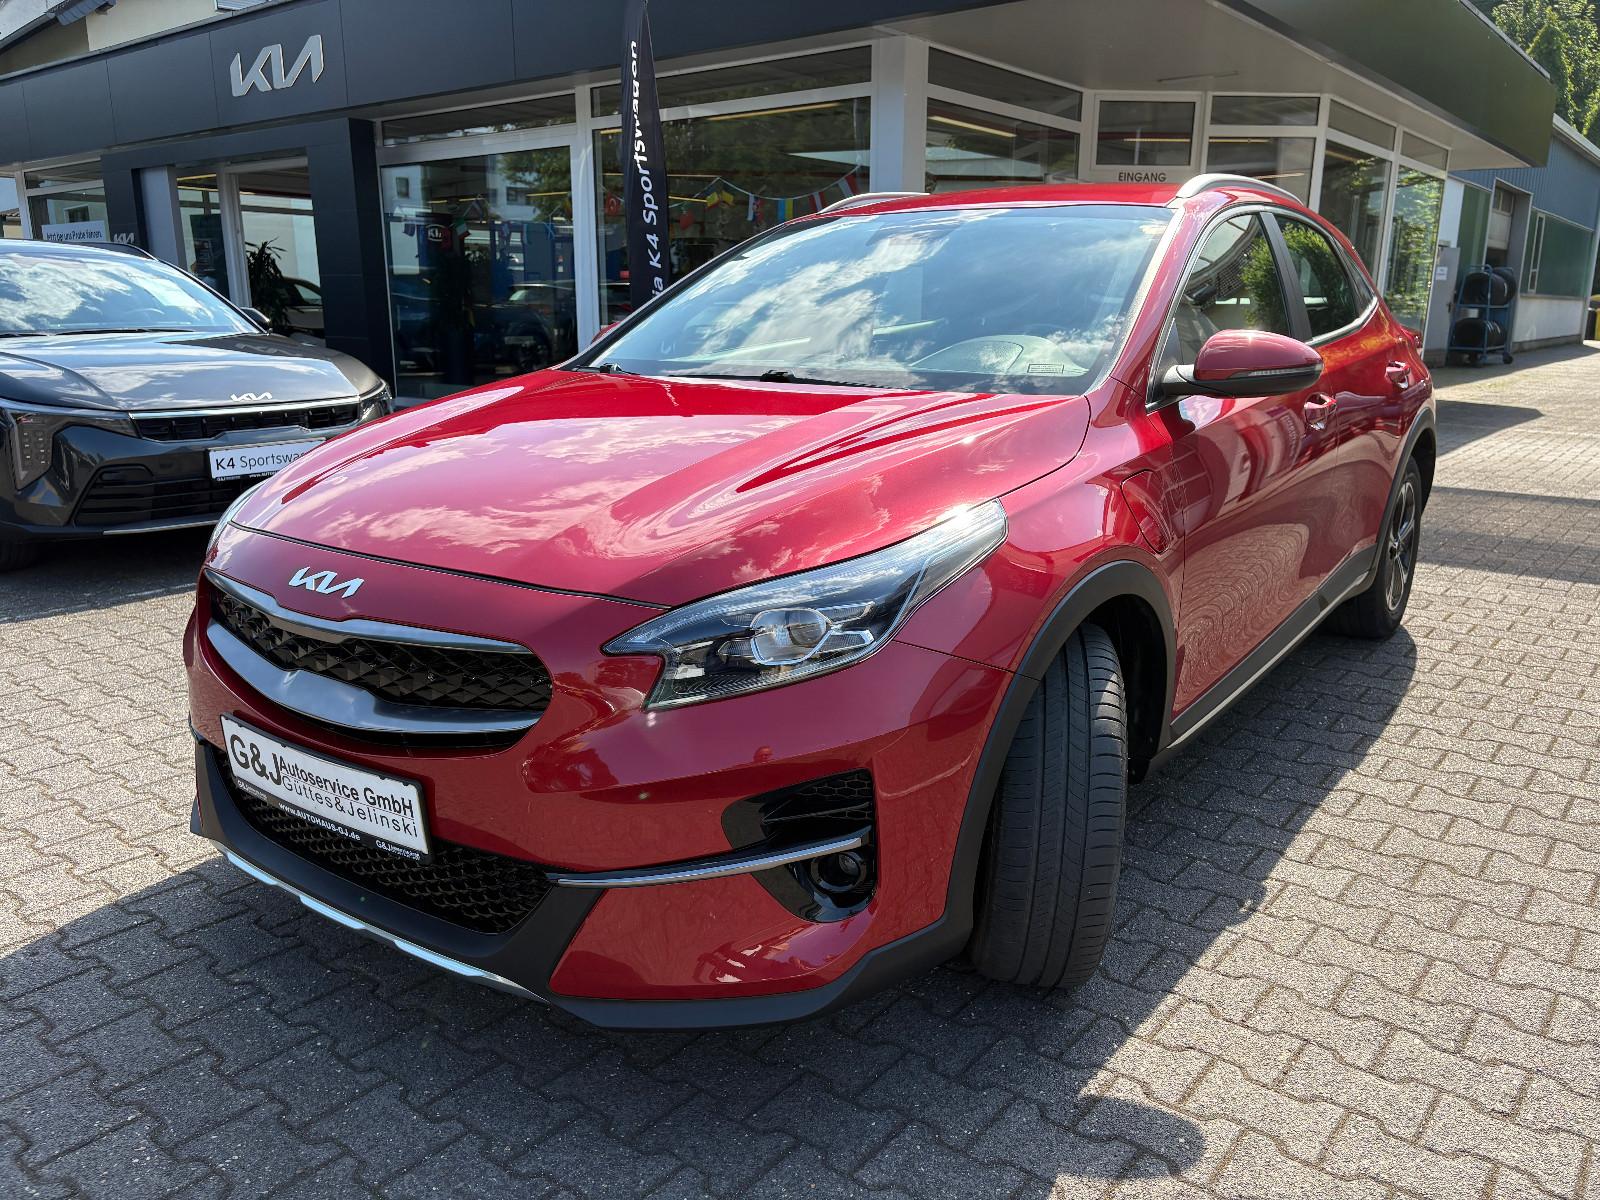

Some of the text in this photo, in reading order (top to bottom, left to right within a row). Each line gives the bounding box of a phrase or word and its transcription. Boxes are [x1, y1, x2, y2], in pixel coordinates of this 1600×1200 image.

[230, 34, 324, 97] KIA
[1118, 171, 1167, 182] EINGANG
[646, 233, 662, 269] K4
[230, 391, 273, 402] KIA
[216, 452, 304, 471] K4 Sportswa
[288, 566, 365, 599] KIA
[230, 733, 282, 786] G&J
[280, 755, 415, 819] Autoservice GmbH
[282, 775, 418, 838] Güttes&Jelinski
